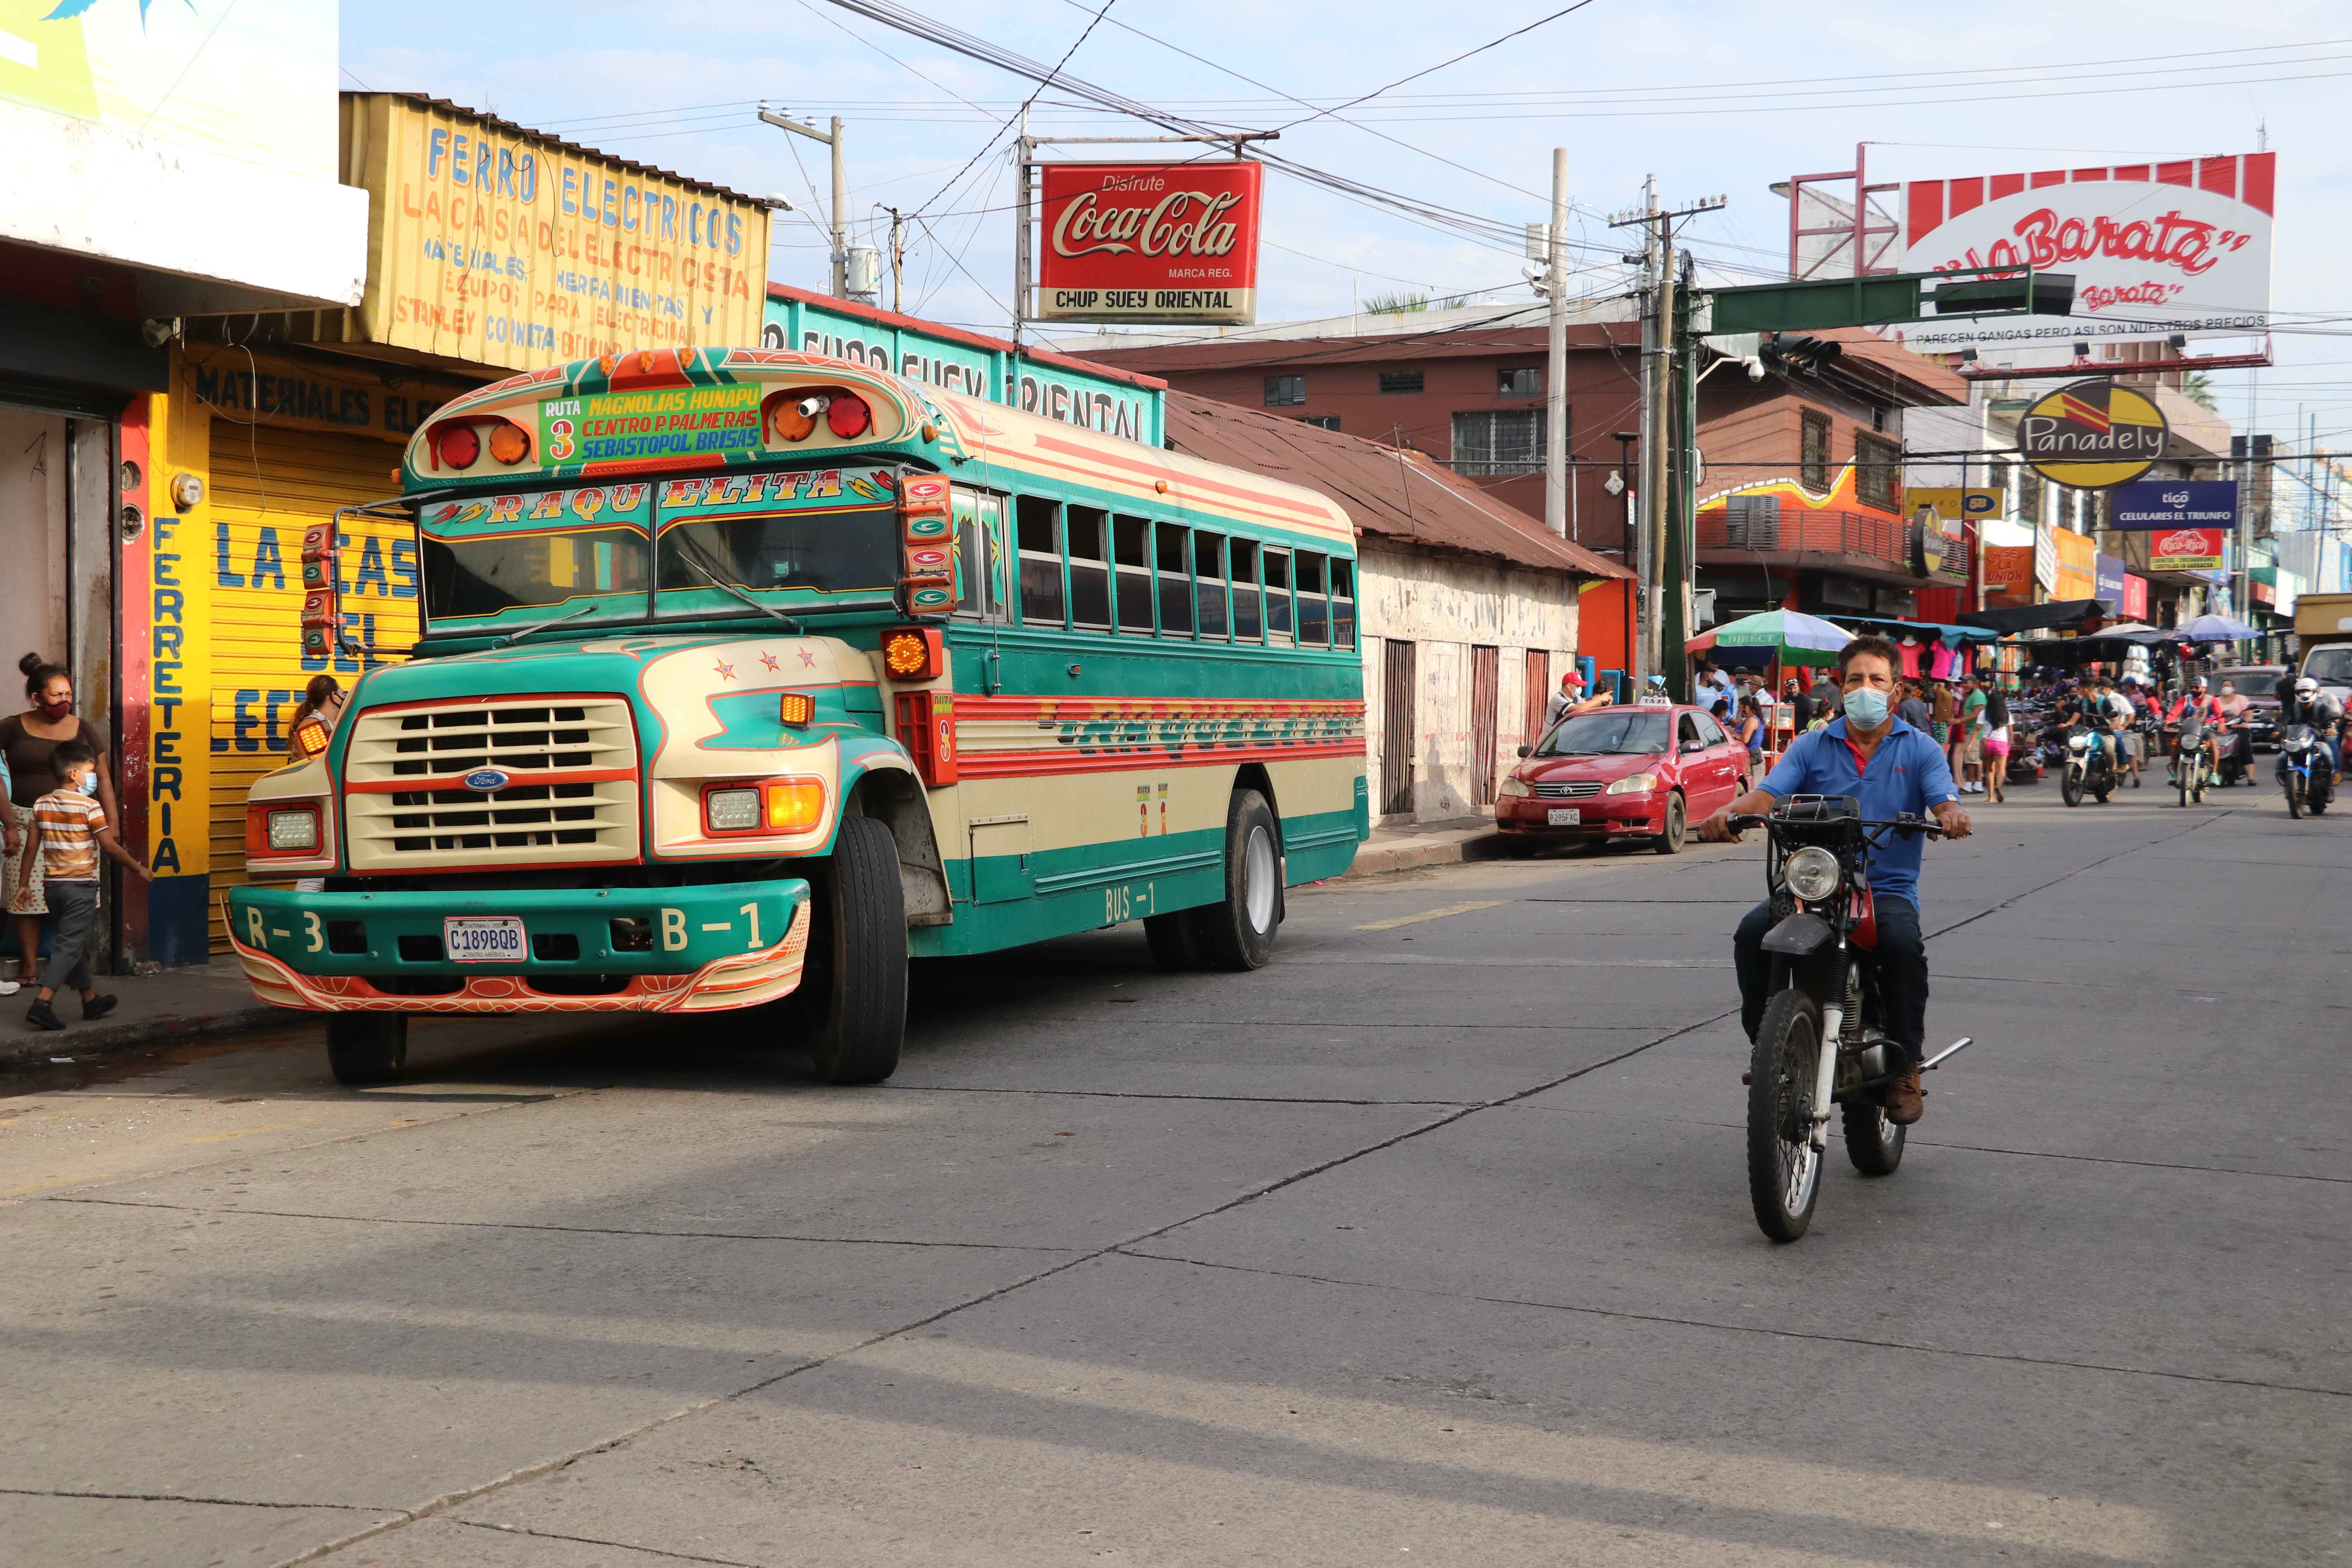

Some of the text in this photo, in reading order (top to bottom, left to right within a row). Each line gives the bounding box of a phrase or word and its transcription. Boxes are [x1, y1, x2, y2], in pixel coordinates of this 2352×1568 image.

[428, 128, 743, 260] FERRO ELECTRICOS
[1102, 174, 1165, 192] Disfrute
[1052, 191, 1244, 257] Coca-Cola
[403, 183, 442, 224] LA
[450, 197, 530, 247] CASA
[585, 233, 750, 301] ELECTRICISTA
[1168, 267, 1233, 278] MARCA REG.
[535, 290, 580, 319] PARA
[1056, 290, 1233, 308] CHUP SUEY ORIENTAL
[396, 295, 476, 336] STANLEY
[701, 305, 713, 325] Y
[1916, 315, 2265, 345] PARECEN GANGAS PERO ASI SON NUESTROS PRECIOS
[196, 365, 372, 427] MATERIALES
[545, 399, 581, 417] RUTA
[588, 387, 759, 417] MAGNOLIAS HUNAPU
[582, 415, 651, 437] CENTRO
[668, 409, 758, 431] PALMERAS
[549, 419, 575, 460] 3
[581, 428, 760, 459] SEBASTOPOL BRISAS
[2024, 417, 2164, 459] Panadely
[2119, 511, 2232, 521] CELULARES EL TRIUNFO
[216, 523, 285, 590] LA
[1987, 548, 2026, 565] UNISEX
[2162, 539, 2205, 552] Rico-Rico
[1987, 571, 2024, 583] UNION
[1998, 561, 2013, 571] LA
[1728, 634, 1774, 643] DIRECT
[152, 517, 185, 874] FERRETERIA
[933, 694, 953, 714] RUTA
[939, 719, 951, 762] 3
[474, 774, 497, 785] Ford
[1140, 801, 1167, 838] 3 1
[1550, 813, 1578, 822] P295FXC
[1106, 885, 1130, 924] BUS
[451, 929, 519, 950] C189BQB
